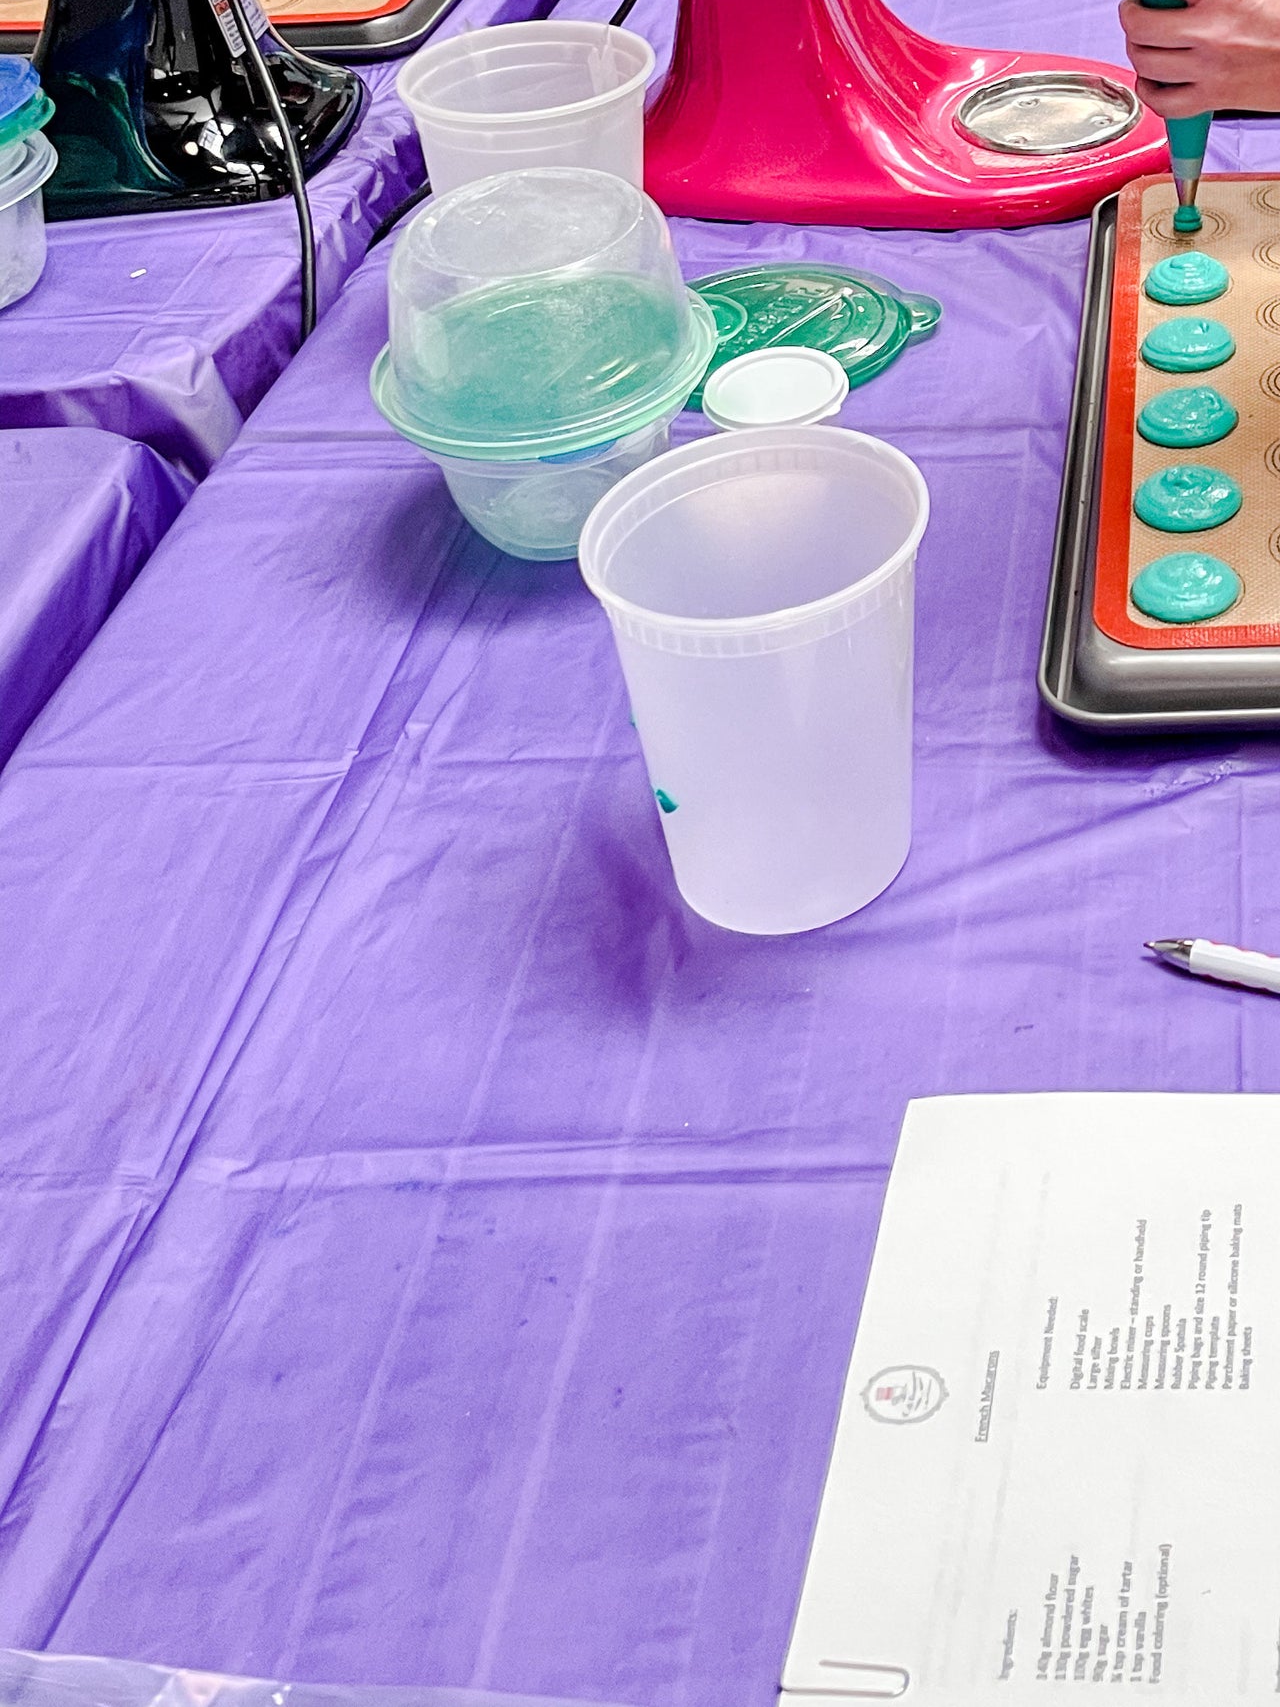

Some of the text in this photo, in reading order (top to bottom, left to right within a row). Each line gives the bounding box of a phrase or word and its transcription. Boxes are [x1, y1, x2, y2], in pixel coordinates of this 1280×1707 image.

[1233, 1204, 1242, 1226] mats
[1133, 1220, 1147, 1262] handheld
[1199, 1224, 1212, 1251] piping
[1229, 1228, 1243, 1258] baking
[1197, 1254, 1207, 1281] round
[1227, 1260, 1239, 1294] silicone
[1129, 1276, 1144, 1316] standing
[1194, 1297, 1205, 1314] size
[1126, 1326, 1136, 1352] mixer
[1193, 1317, 1203, 1334] and
[1227, 1310, 1238, 1336] paper
[1036, 1337, 1052, 1390] Equipment
[1069, 1309, 1089, 1390] Digital food scale
[1086, 1336, 1102, 1390] Large sifter
[1104, 1328, 1120, 1390] Mixing bowls
[1137, 1316, 1155, 1390] Measuring cups
[1154, 1304, 1171, 1389] Measuring spoons
[1170, 1318, 1187, 1389] Rubber Spatula
[1190, 1337, 1204, 1358] bags
[1205, 1316, 1220, 1390] Piping template
[1222, 1339, 1235, 1389] Parchment
[1238, 1327, 1253, 1390] Baking sheets
[1120, 1355, 1134, 1390] Electric
[1187, 1361, 1202, 1390] Piping
[975, 1351, 998, 1442] French Macarons
[1045, 1574, 1059, 1601] flour
[1067, 1555, 1080, 1586] sugar
[1120, 1562, 1132, 1593] tartar
[1060, 1588, 1075, 1648] powdered
[1080, 1586, 1094, 1625] whites
[1148, 1544, 1172, 1684] Food coloring (optional)
[1040, 1604, 1056, 1648] almond
[1079, 1628, 1092, 1649] egg
[1097, 1624, 1109, 1657] sugar
[1116, 1611, 1128, 1648] cream
[1134, 1612, 1147, 1650] vanilla
[1113, 1651, 1126, 1670] tsp
[1131, 1653, 1145, 1672] tsp
